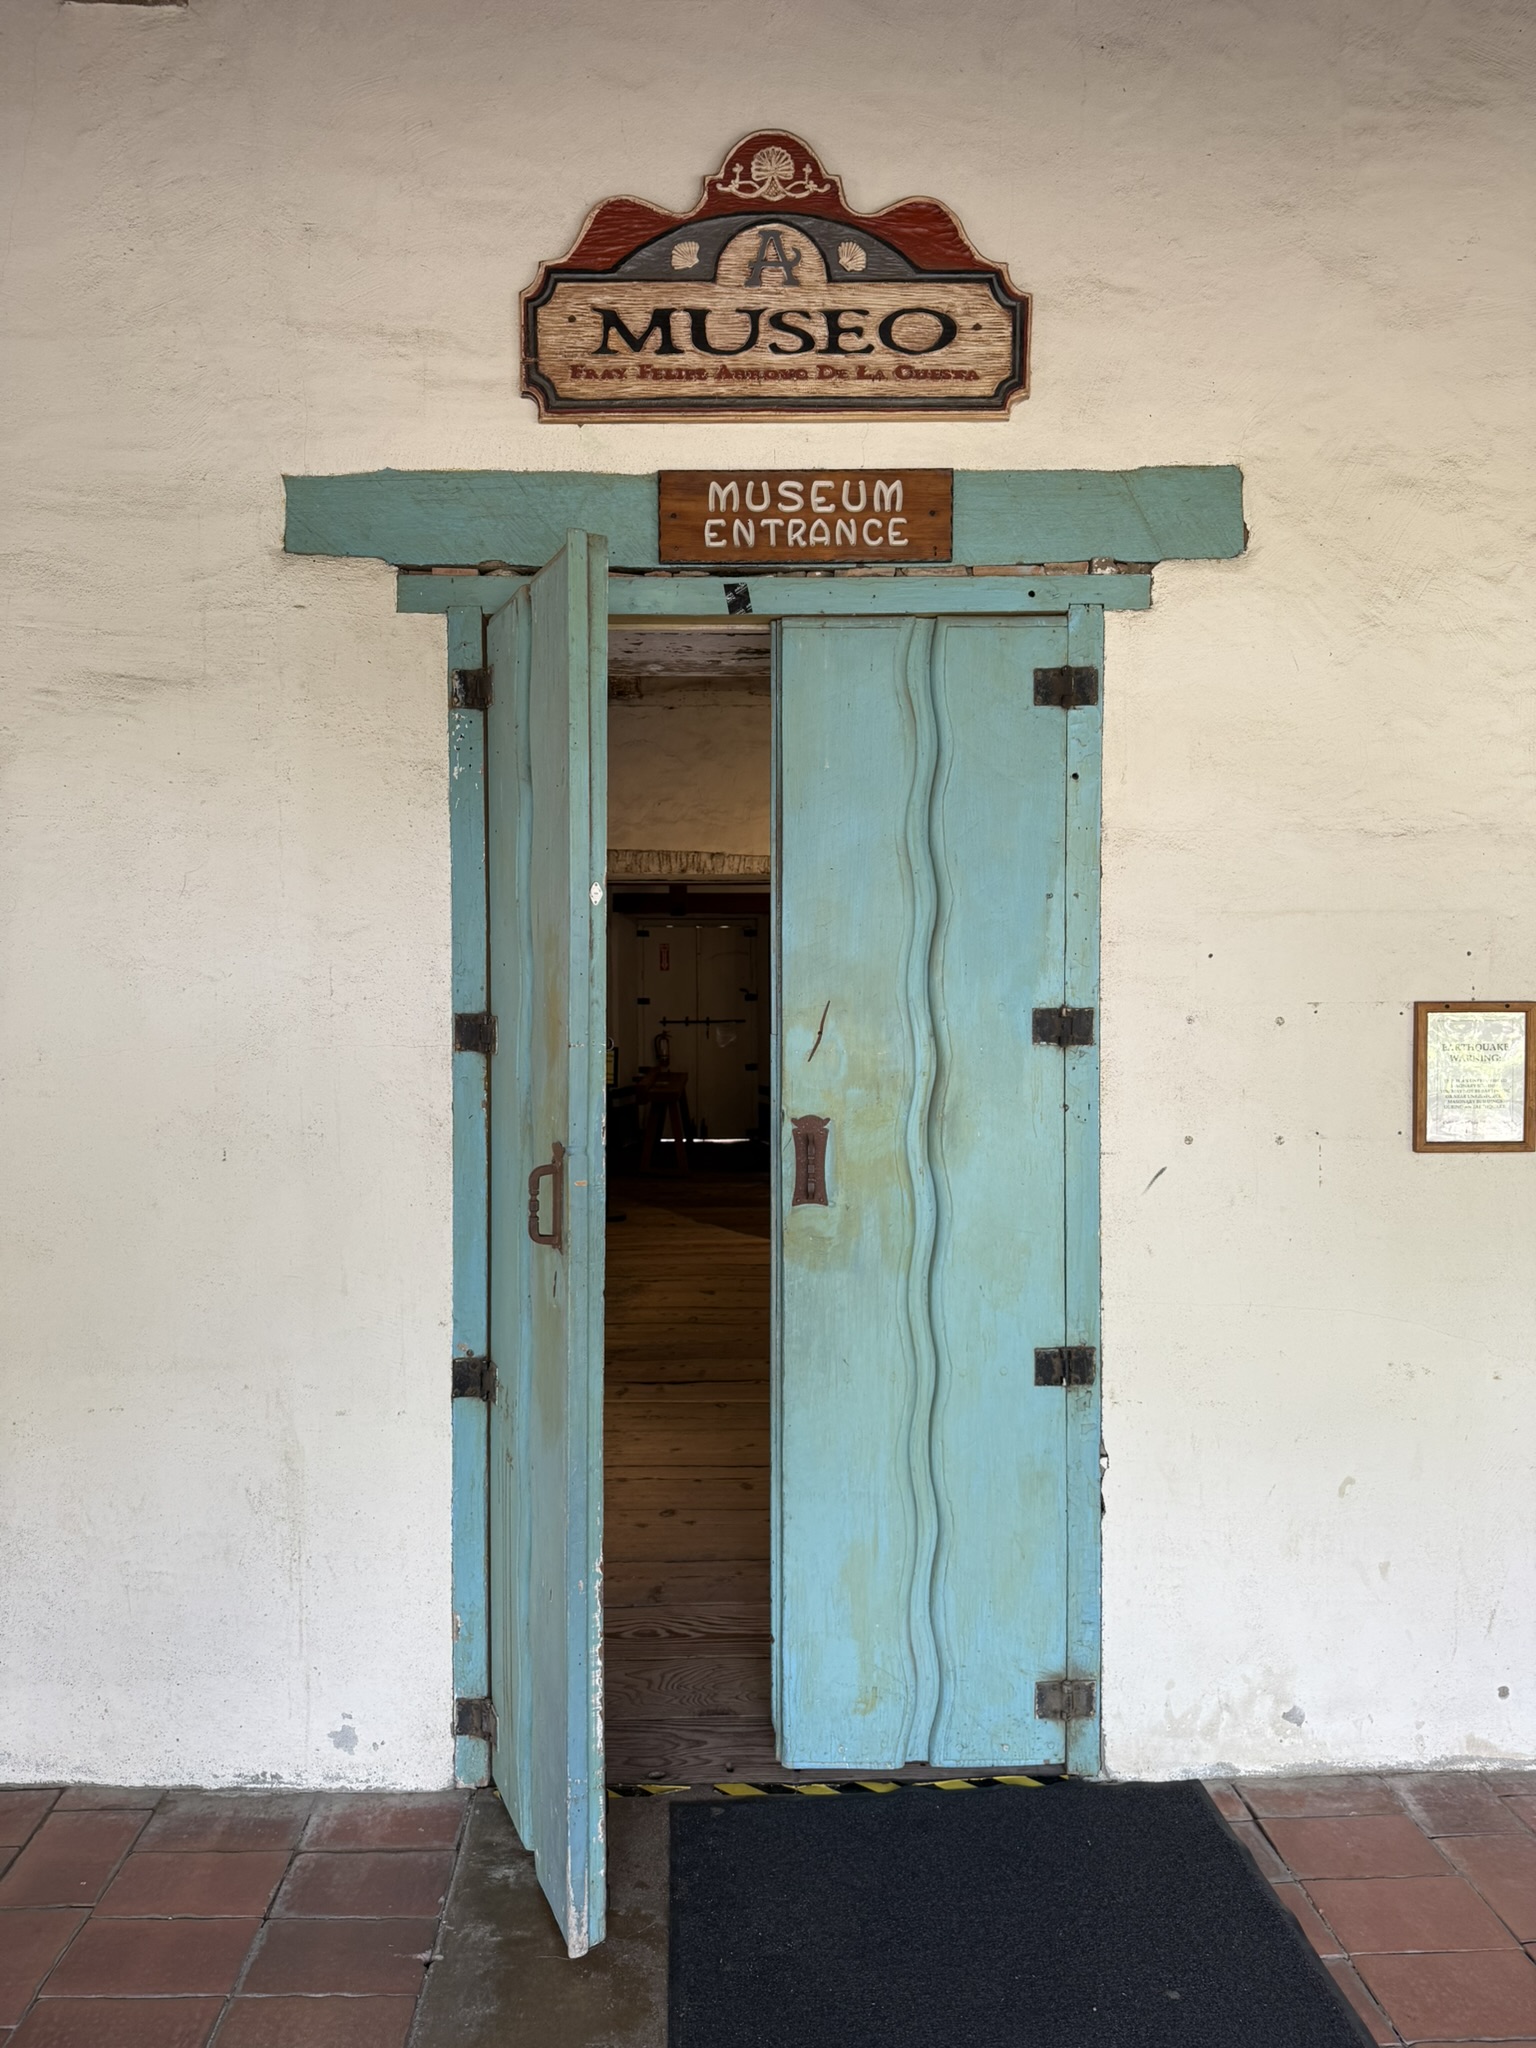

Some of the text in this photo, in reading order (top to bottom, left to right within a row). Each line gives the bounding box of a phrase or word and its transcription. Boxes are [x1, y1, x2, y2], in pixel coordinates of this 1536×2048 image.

[591, 307, 958, 356] MUSEO
[707, 478, 904, 513] MUSEUM
[703, 517, 910, 549] ENTRANCE
